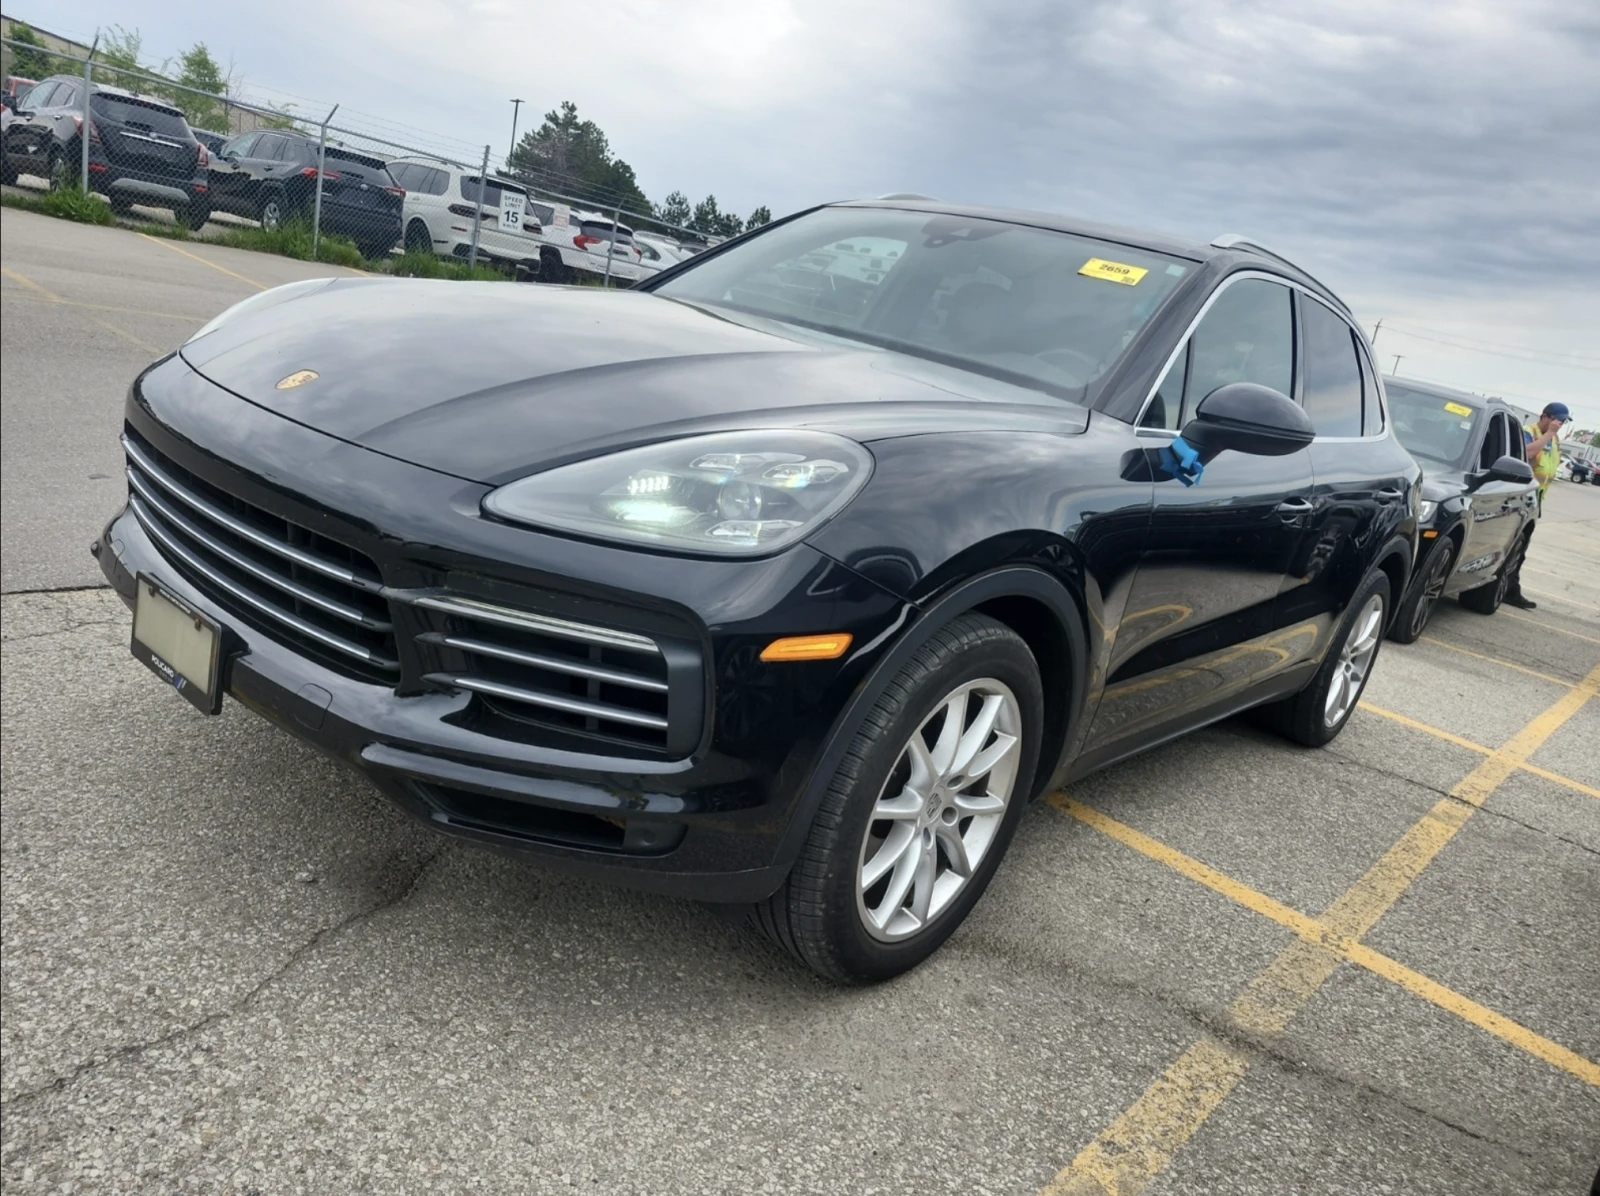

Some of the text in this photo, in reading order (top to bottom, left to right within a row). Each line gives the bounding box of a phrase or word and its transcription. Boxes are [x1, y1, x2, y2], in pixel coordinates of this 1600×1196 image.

[504, 195, 523, 204] SPEED
[504, 210, 519, 224] 15
[1099, 263, 1130, 275] 2659
[151, 654, 175, 678] POLICARO
